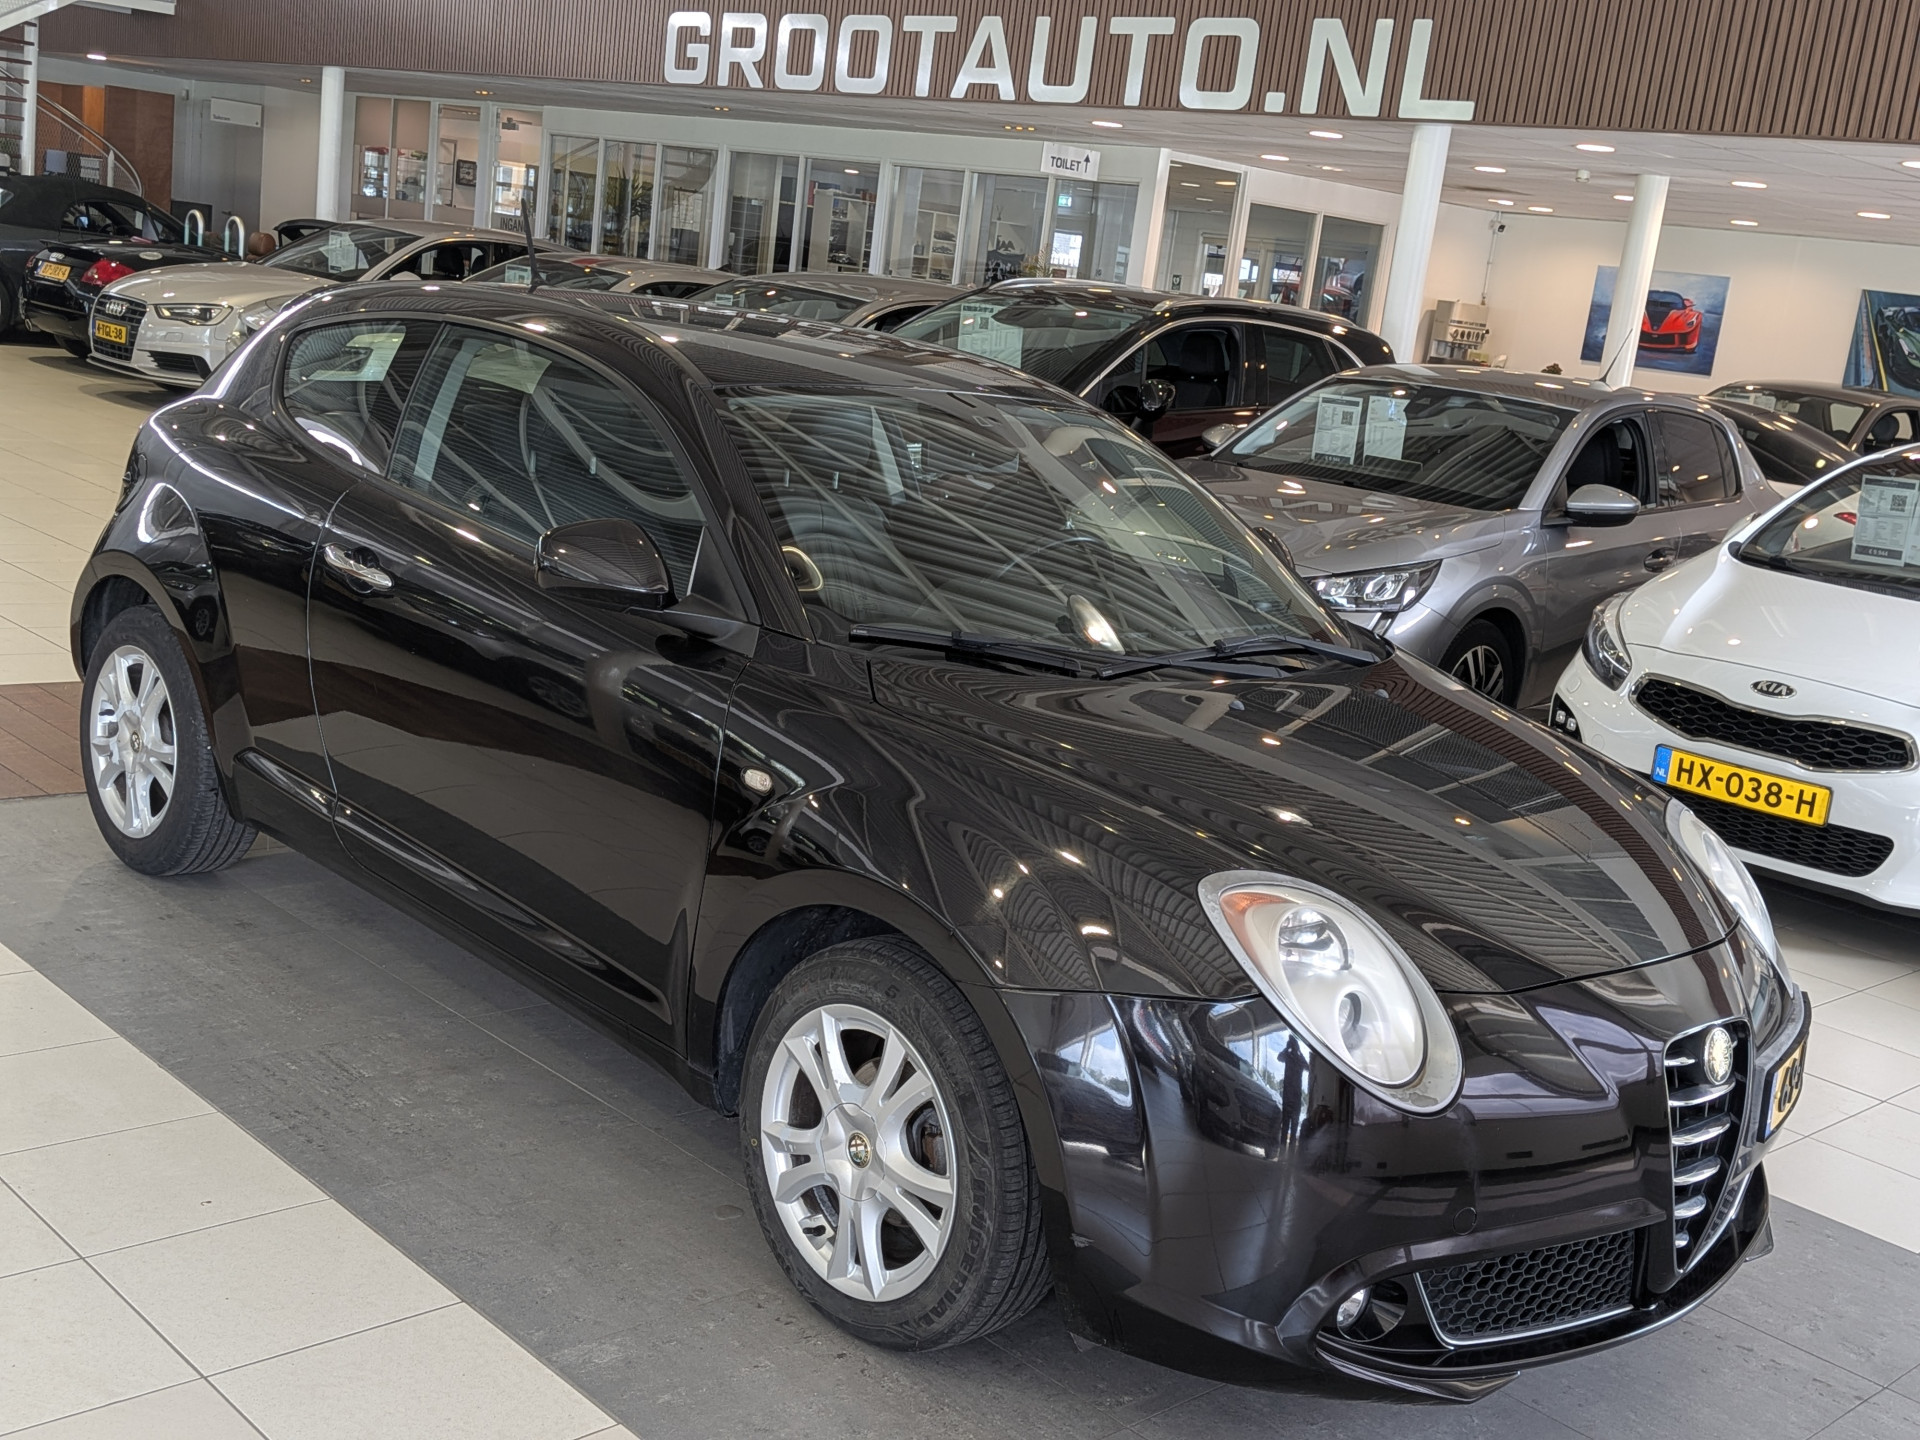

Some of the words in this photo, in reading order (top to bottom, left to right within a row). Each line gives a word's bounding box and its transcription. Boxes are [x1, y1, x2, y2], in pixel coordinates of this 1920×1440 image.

[664, 11, 1475, 121] GROOTAUTO.NL
[1050, 155, 1081, 171] TOILET
[501, 216, 527, 232] INGAN
[96, 323, 123, 340] 4-TGL-38
[1756, 680, 1791, 696] KIA
[1655, 767, 1666, 778] NL
[1675, 757, 1818, 818] HX-038-H
